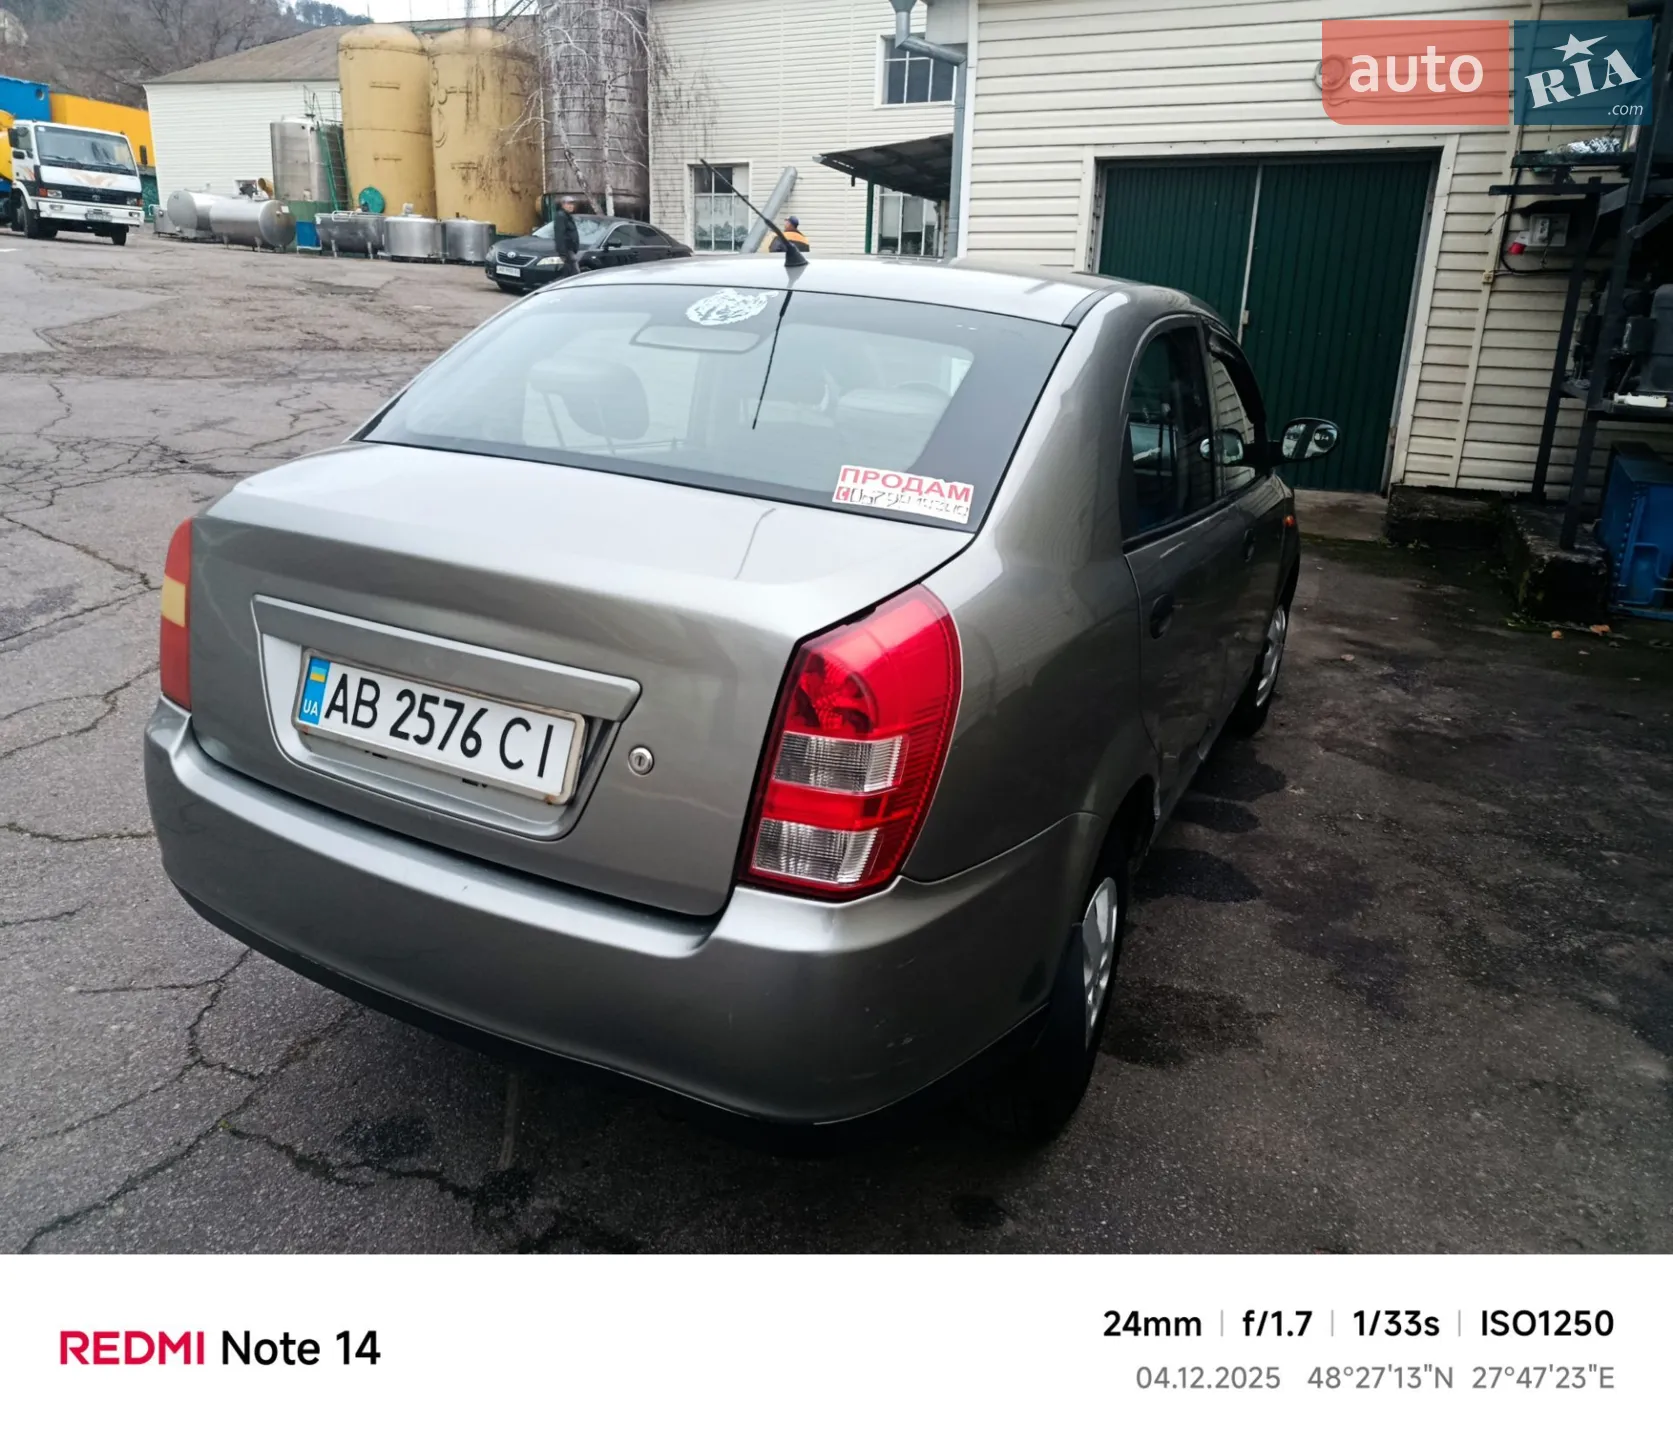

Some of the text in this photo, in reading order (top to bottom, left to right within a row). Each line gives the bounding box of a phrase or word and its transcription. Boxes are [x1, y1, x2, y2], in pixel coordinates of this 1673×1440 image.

[840, 467, 972, 503] ПРОДАМ
[302, 698, 320, 718] UA
[324, 673, 554, 778] AB 2576 CI
